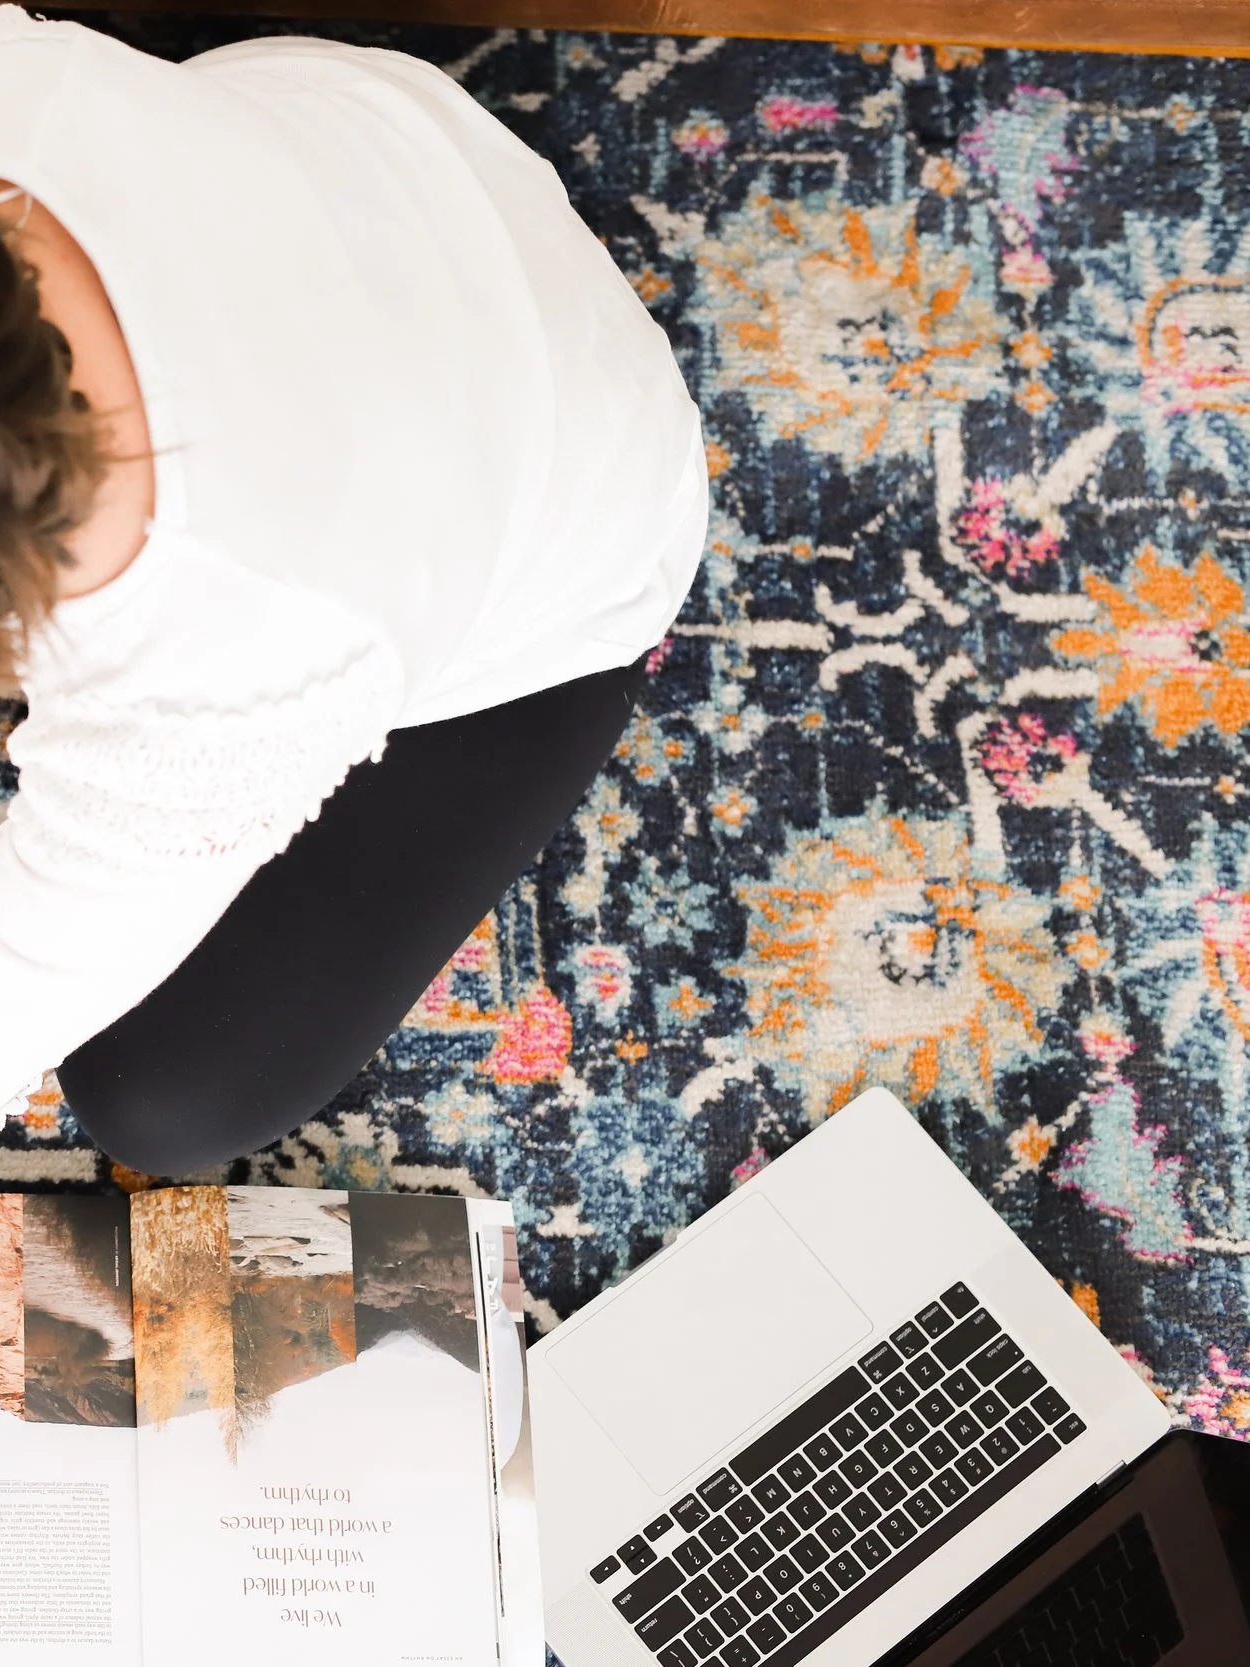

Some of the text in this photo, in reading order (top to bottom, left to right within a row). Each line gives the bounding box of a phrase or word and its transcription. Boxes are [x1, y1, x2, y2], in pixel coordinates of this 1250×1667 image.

[920, 1366, 930, 1375] Z
[895, 1386, 904, 1396] X
[956, 1382, 964, 1391] A
[870, 1406, 878, 1415] C
[931, 1403, 939, 1412] S
[984, 1404, 994, 1413] Q
[845, 1427, 853, 1436] V
[905, 1423, 914, 1432] D
[959, 1424, 970, 1435] W
[992, 1437, 1000, 1446] 2
[819, 1447, 827, 1456] B
[882, 1443, 888, 1452] F
[934, 1445, 943, 1454] E
[967, 1457, 975, 1466] 3
[792, 1467, 802, 1477] N
[854, 1464, 862, 1473] G
[908, 1465, 918, 1474] R
[941, 1479, 948, 1487] 4
[766, 1488, 776, 1498] M
[827, 1484, 837, 1494] H
[884, 1487, 892, 1495] T
[260, 1486, 350, 1505] to rhythm.
[915, 1499, 924, 1508] 5
[802, 1505, 808, 1514] J
[858, 1507, 866, 1516] Y
[220, 1516, 391, 1536] a world that dances
[890, 1520, 898, 1528] 6
[776, 1526, 785, 1535] K
[831, 1527, 840, 1537] U
[865, 1540, 872, 1549] 7
[252, 1545, 363, 1567] with rhythm,
[837, 1561, 846, 1570] 8
[779, 1569, 787, 1578] O
[243, 1577, 374, 1597] in a world filled
[812, 1582, 820, 1591] 9
[755, 1590, 762, 1599] P
[785, 1604, 793, 1612] 0
[280, 1608, 341, 1627] We live
